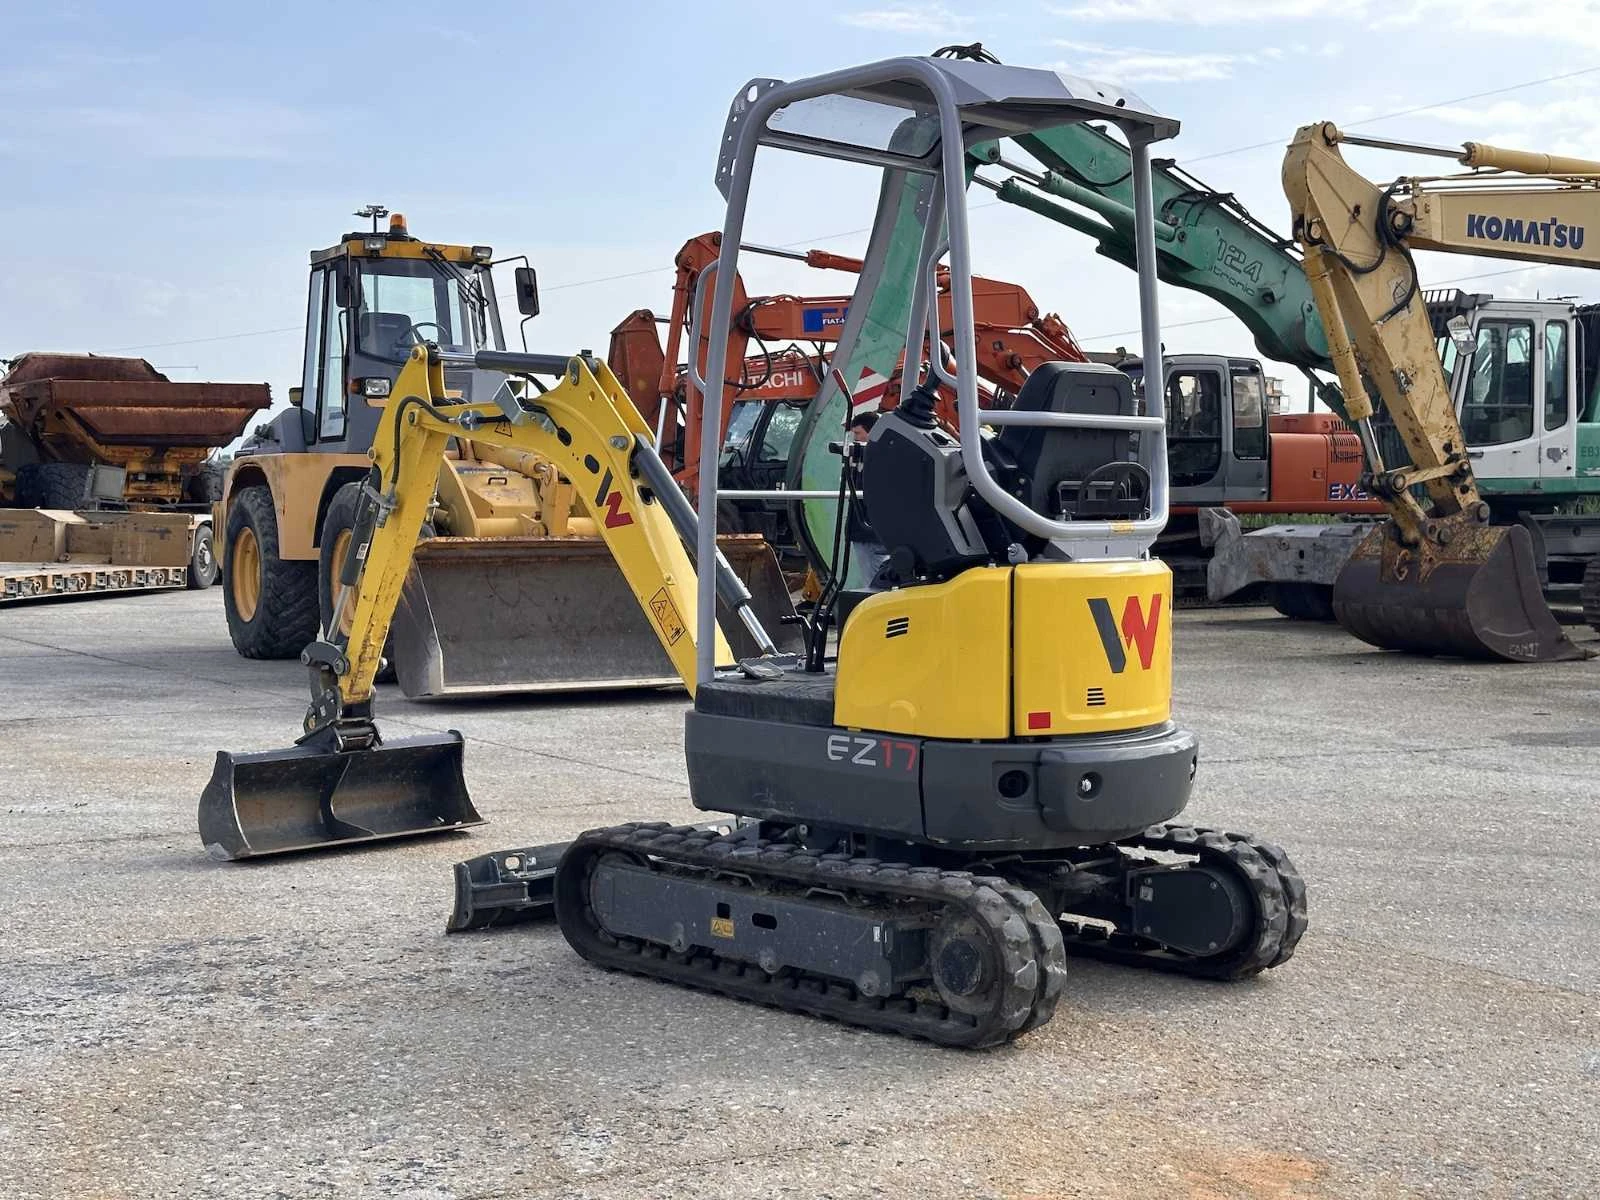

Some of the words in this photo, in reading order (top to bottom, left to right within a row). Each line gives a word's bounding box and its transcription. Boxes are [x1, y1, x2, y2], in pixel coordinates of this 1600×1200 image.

[1467, 214, 1584, 249] KOMATSU
[1087, 594, 1162, 673] W
[827, 735, 917, 772] EZ17
